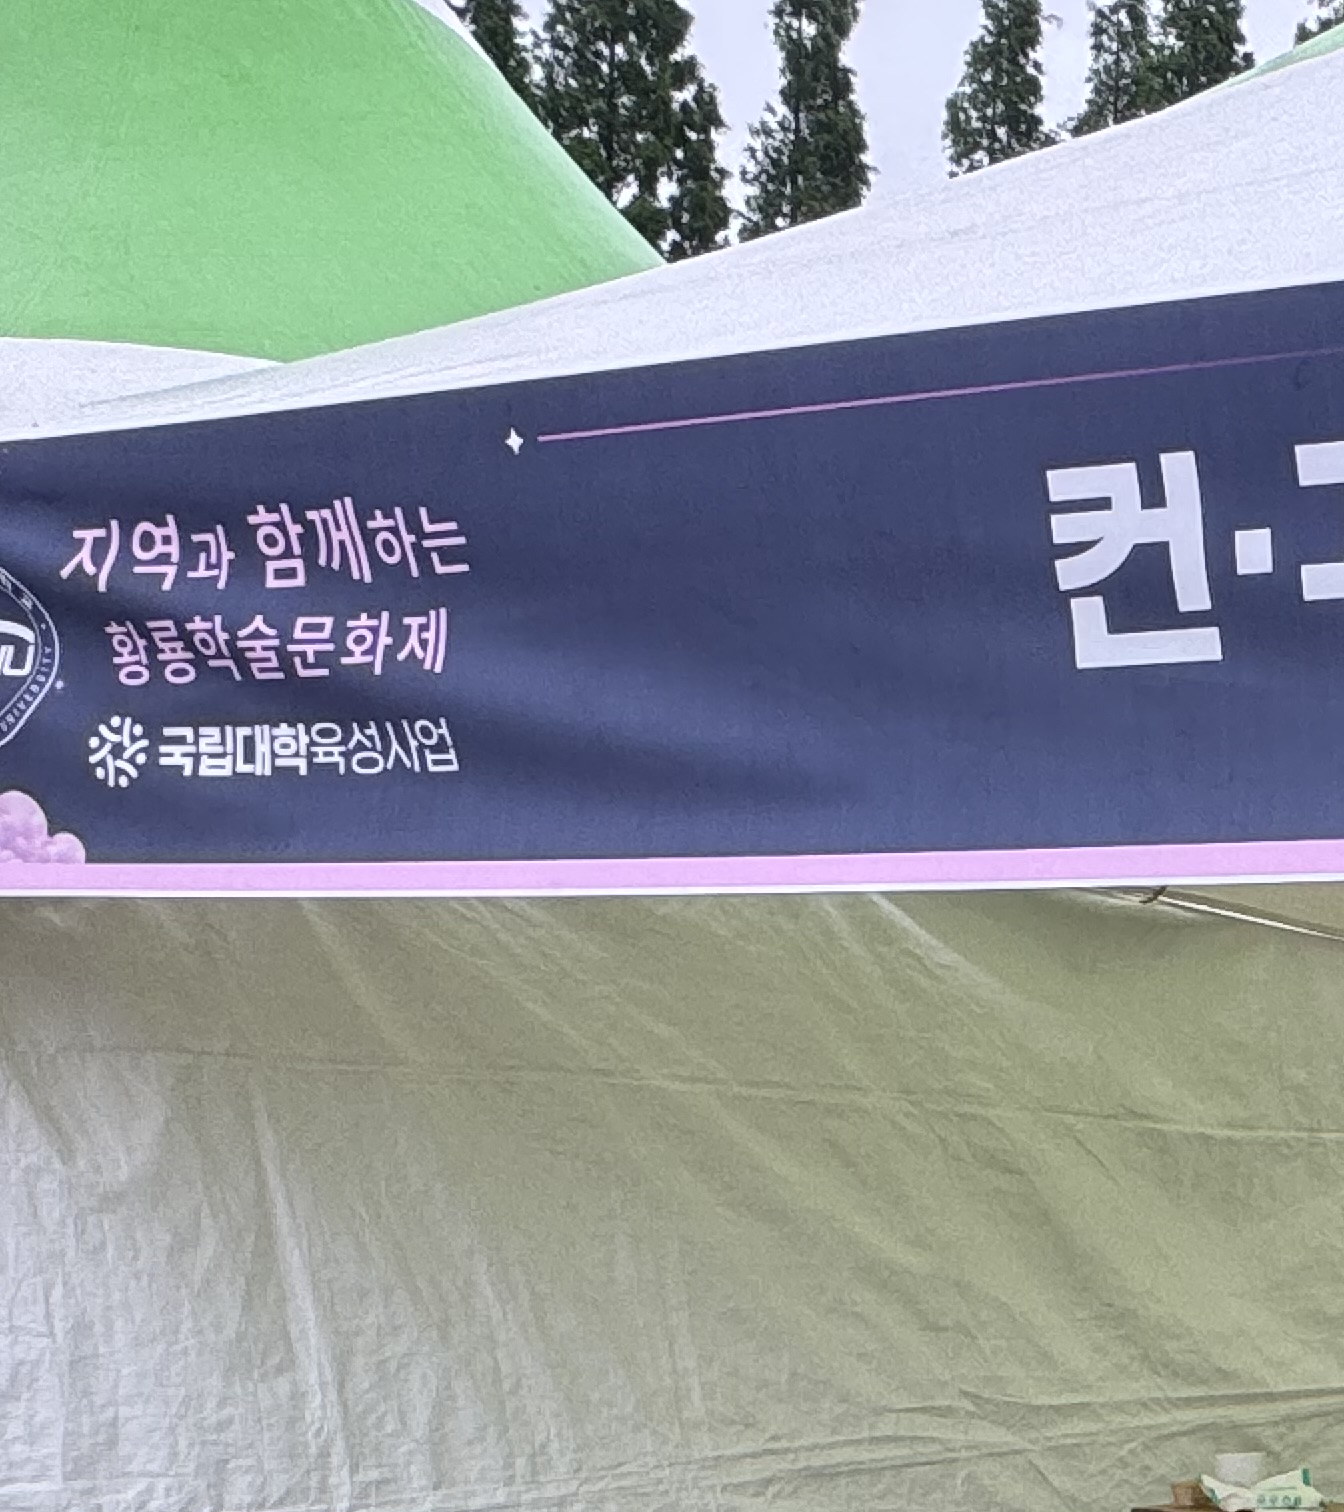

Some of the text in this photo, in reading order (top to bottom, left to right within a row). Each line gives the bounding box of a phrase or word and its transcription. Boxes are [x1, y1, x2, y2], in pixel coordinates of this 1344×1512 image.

[60, 513, 236, 592] 지역과
[246, 496, 471, 589] 함께하는
[103, 606, 448, 686] 황룡학술문화제
